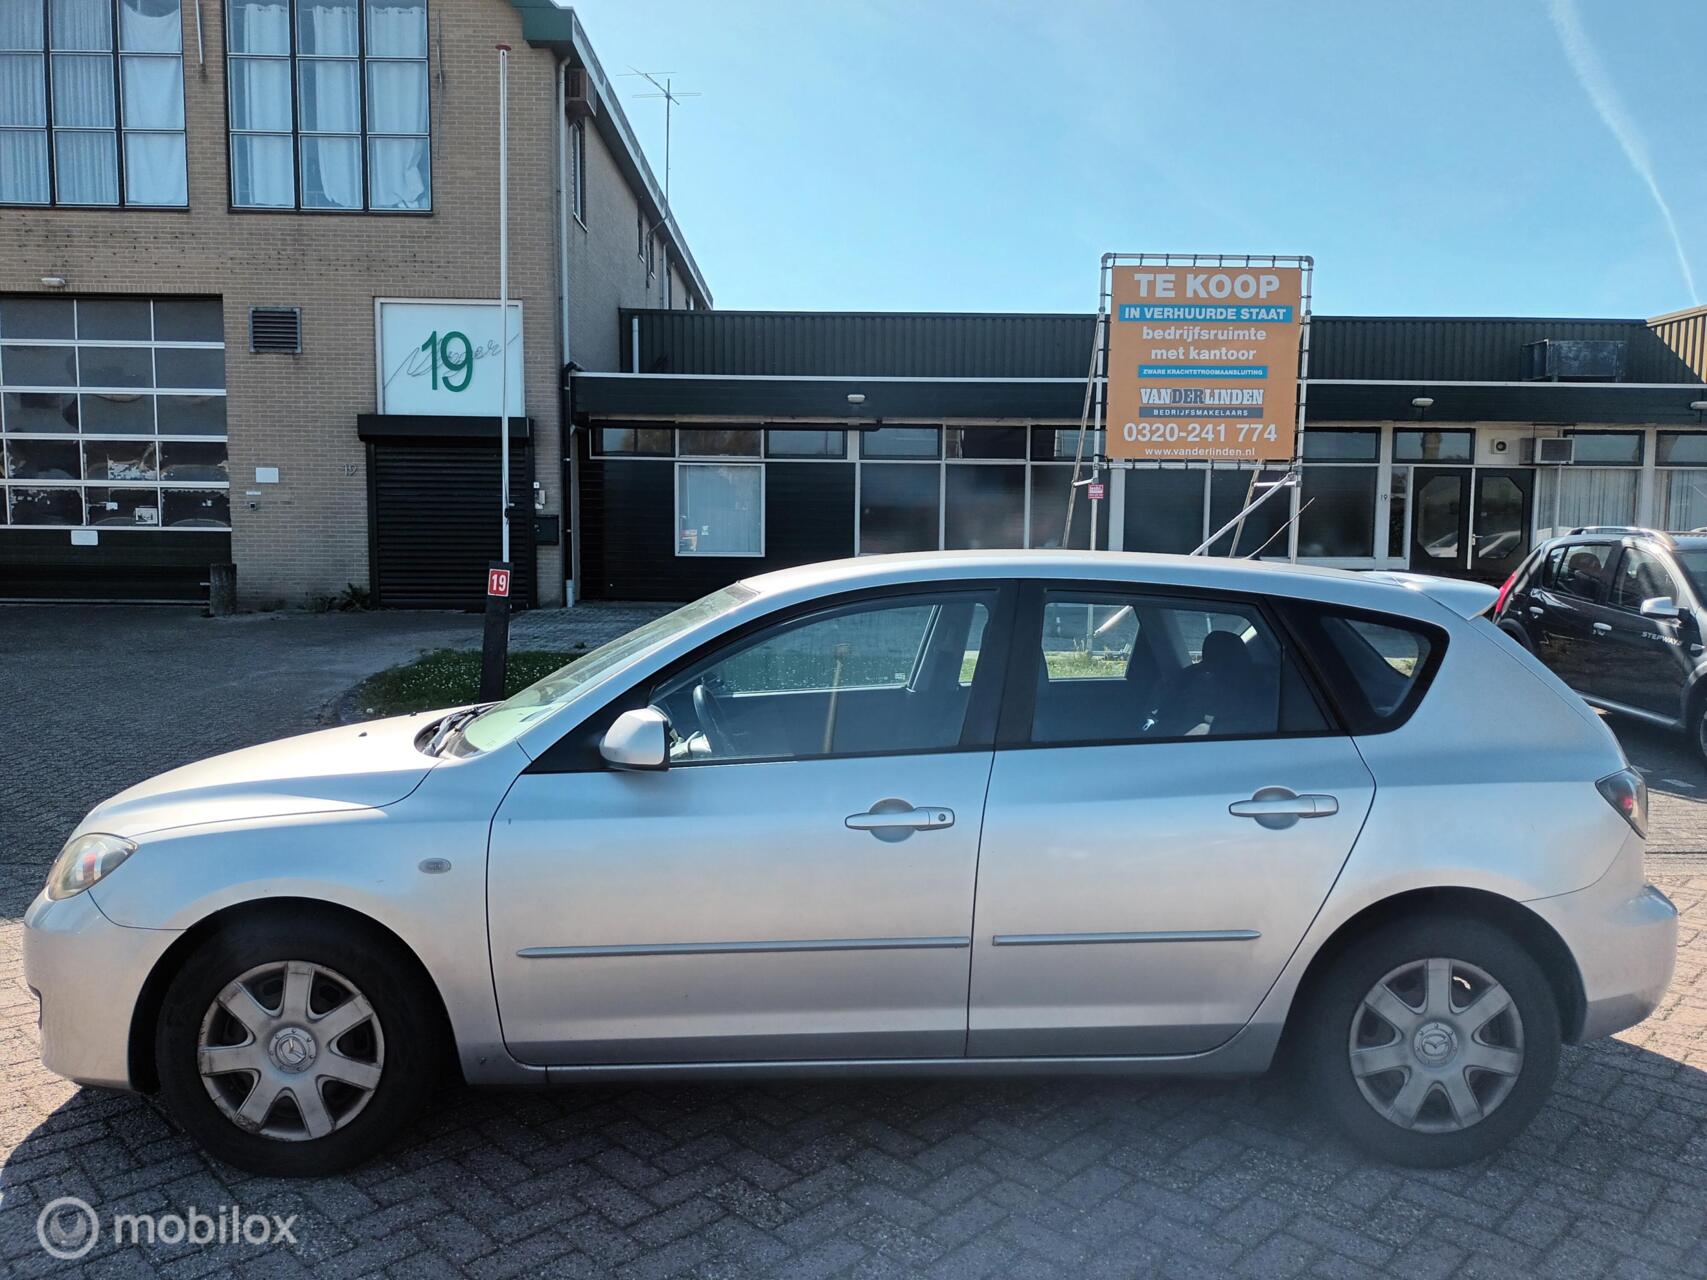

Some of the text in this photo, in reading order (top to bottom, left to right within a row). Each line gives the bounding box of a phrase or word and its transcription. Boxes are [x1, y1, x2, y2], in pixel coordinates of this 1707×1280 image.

[1134, 273, 1280, 299] TE KOOP
[1124, 307, 1287, 320] IN VERHUURDE STAAT
[1142, 326, 1267, 342] bedrijfsruimte
[421, 330, 474, 393] 19
[1151, 346, 1257, 360] met kantoor
[1140, 388, 1264, 405] VANDERLINDEN
[1123, 422, 1277, 442] 0320-241 774
[1144, 447, 1255, 457] www.vanderlinden.nl
[491, 573, 507, 592] 19
